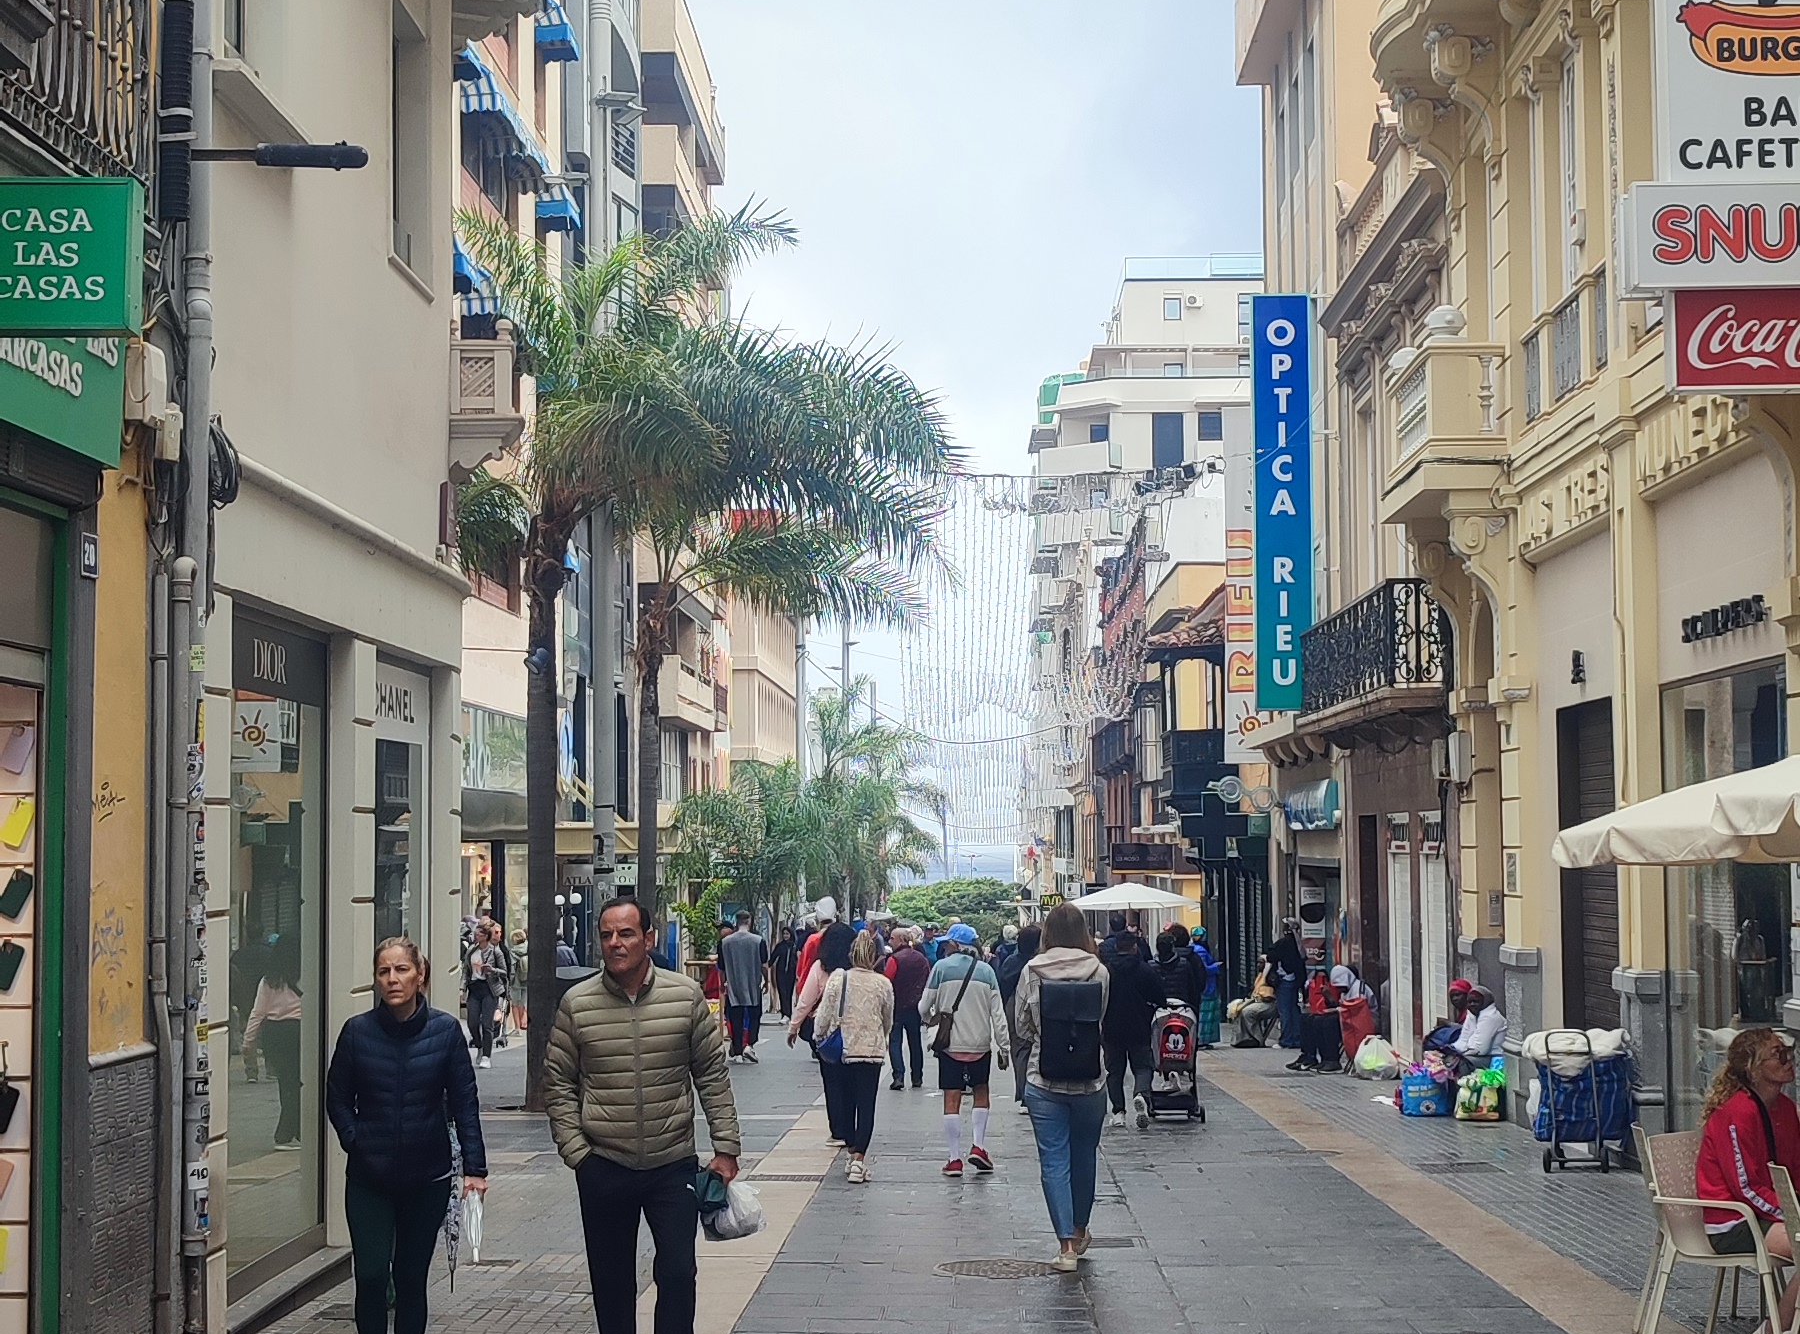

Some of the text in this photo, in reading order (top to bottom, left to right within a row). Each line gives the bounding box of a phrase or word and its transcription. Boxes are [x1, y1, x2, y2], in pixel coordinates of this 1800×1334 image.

[1716, 36, 1800, 63] BURG
[2, 208, 93, 234] CASA
[13, 242, 79, 267] LAS
[1266, 318, 1297, 686] OPTICA RIEU
[85, 541, 96, 567] 20
[253, 637, 287, 685] DIOR
